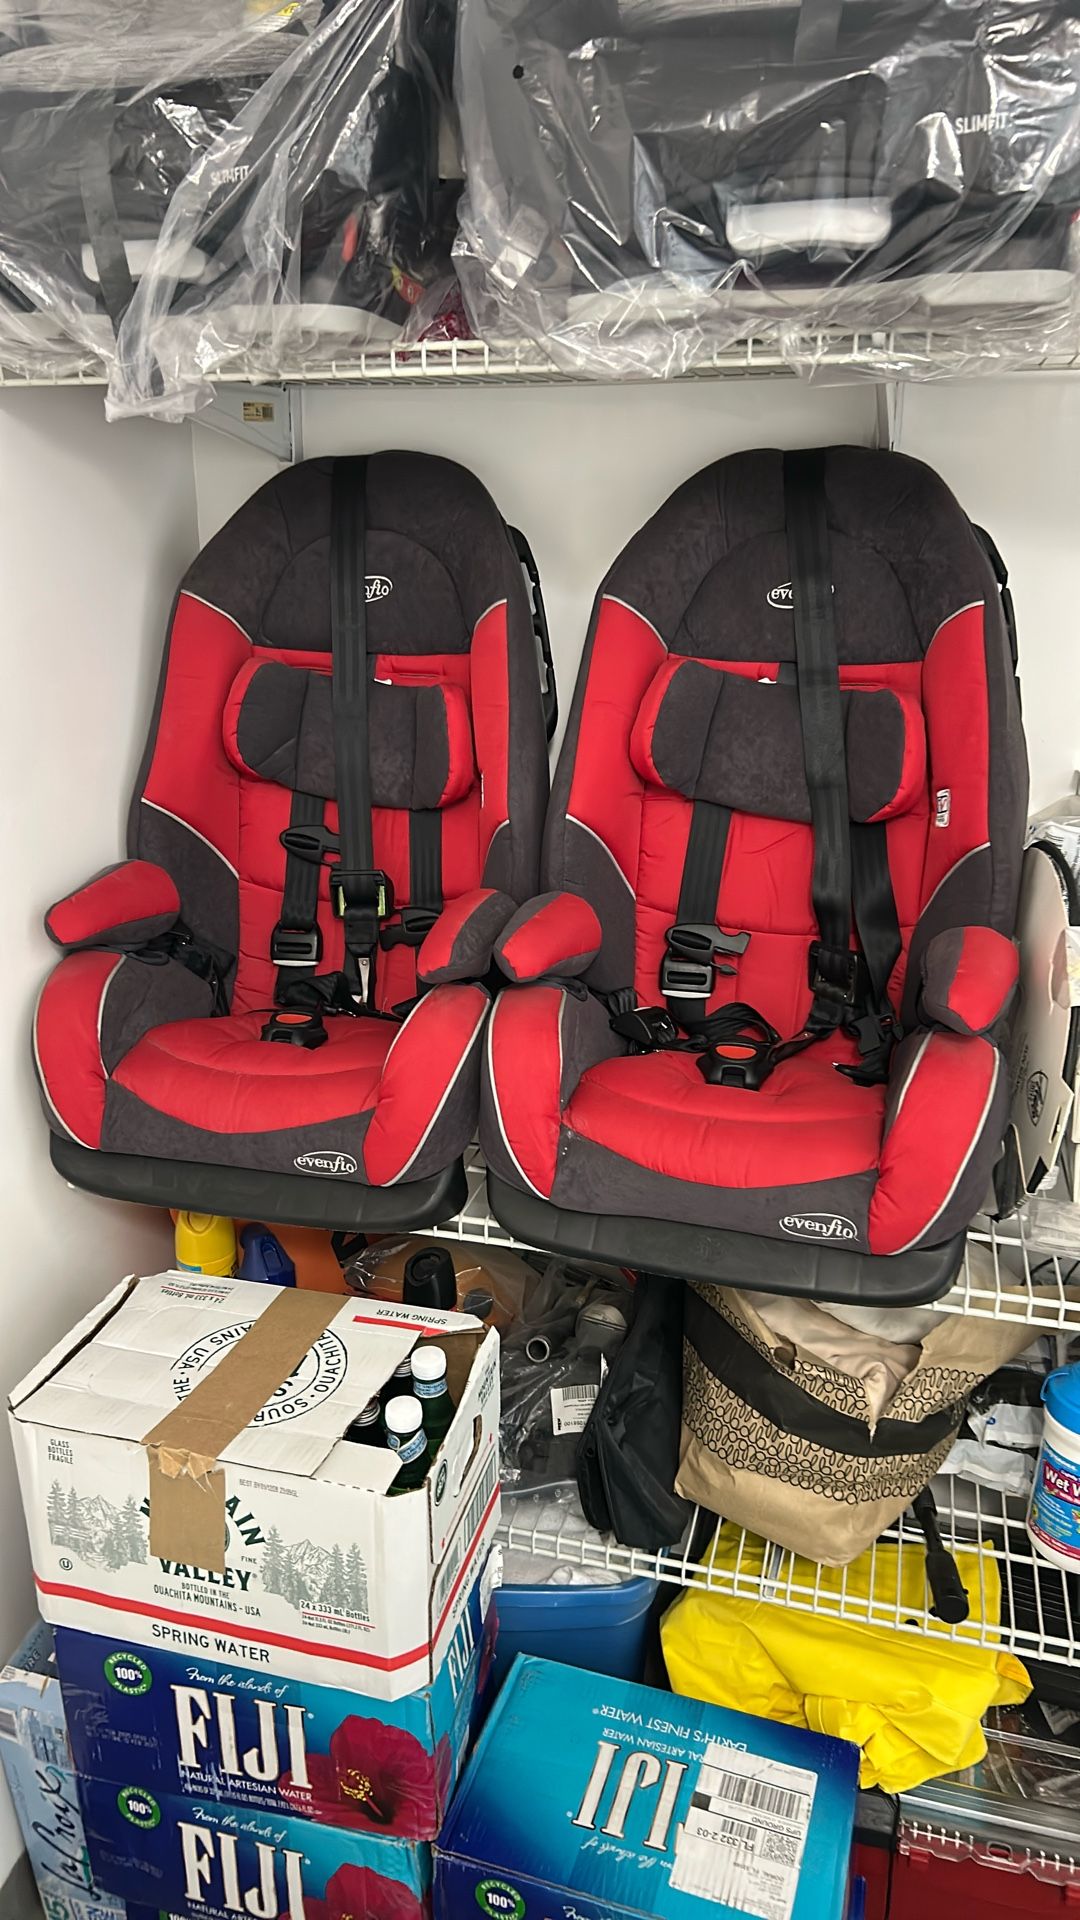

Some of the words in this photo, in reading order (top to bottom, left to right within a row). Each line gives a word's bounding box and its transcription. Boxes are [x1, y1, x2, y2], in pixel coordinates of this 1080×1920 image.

[955, 112, 1009, 135] SLIMFIT
[297, 1156, 355, 1173] evenflo
[783, 1216, 853, 1239] evenflo
[376, 1308, 409, 1320] WATER
[411, 1314, 448, 1325] SPRING
[178, 1347, 209, 1370] USA
[1045, 1467, 1070, 1492] Wet
[241, 1556, 257, 1564] FINE
[159, 1557, 251, 1591] VALLEY
[154, 1584, 192, 1602] OUACHITA
[193, 1593, 237, 1612] MOUNTAINS
[245, 1606, 261, 1617] USA
[181, 1582, 208, 1595] BOTTLED
[210, 1588, 216, 1596] IN
[218, 1590, 230, 1599] THE
[300, 1600, 310, 1609] 24
[318, 1604, 332, 1614] 333
[346, 1610, 370, 1622] Bottles
[152, 1624, 209, 1648] SPRING
[214, 1638, 270, 1663] WATER
[447, 1604, 475, 1699] FIJI
[108, 1652, 147, 1670] RECYCLED
[114, 1667, 143, 1681] 100%
[186, 1667, 215, 1684] From
[217, 1673, 236, 1687] the
[238, 1678, 271, 1693] islands
[274, 1684, 289, 1698] of
[600, 1704, 643, 1726] WATER
[170, 1684, 312, 1789] FIJI
[602, 1727, 634, 1744] WATER
[645, 1717, 690, 1739] FINEST
[636, 1737, 686, 1757] ARTESIAN
[228, 1777, 277, 1794] ARTESIAN
[278, 1787, 313, 1802] WATER
[572, 1740, 686, 1856] IJI
[128, 1800, 152, 1815] 100%
[192, 1806, 219, 1824] From
[221, 1815, 239, 1828] the
[273, 1830, 287, 1843] of
[697, 1827, 718, 1840] 2-03
[752, 1816, 785, 1831] GROUND
[720, 1835, 740, 1847] 332
[742, 1841, 755, 1852] FL
[177, 1821, 306, 1920] FIJI
[486, 1892, 516, 1908] 100%
